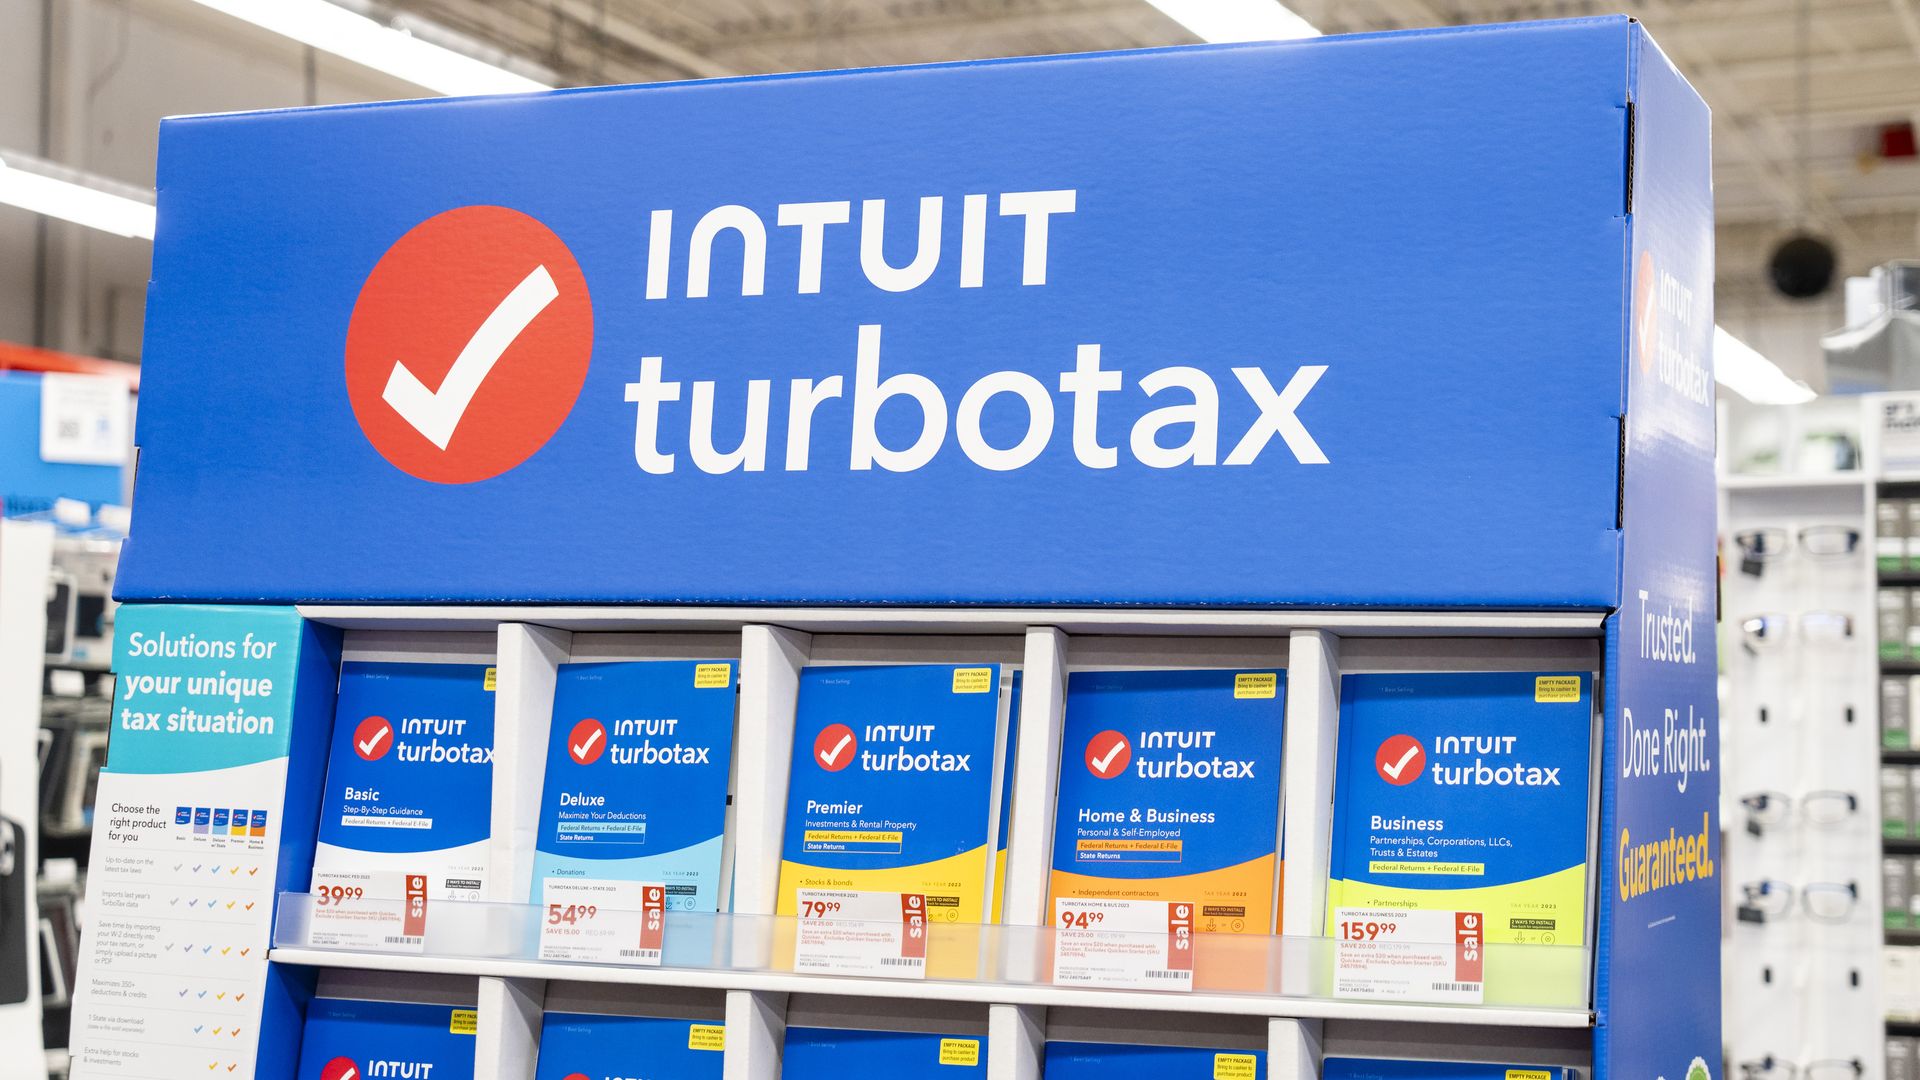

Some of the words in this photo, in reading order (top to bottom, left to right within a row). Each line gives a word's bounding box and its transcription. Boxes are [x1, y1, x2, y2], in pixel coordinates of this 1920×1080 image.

[646, 190, 1076, 299] INTUIT
[1660, 269, 1692, 326] INTUIT
[1659, 331, 1709, 407] turbotax
[624, 324, 1331, 474] turbotax
[1639, 589, 1695, 664] Trusted.
[128, 632, 235, 659] Solutions
[243, 633, 276, 659] for
[124, 675, 181, 700] your
[187, 671, 272, 703] unique
[121, 708, 160, 731] tax
[166, 706, 274, 734] situation
[401, 719, 466, 735] INTUIT
[614, 719, 678, 735] INTUIT
[865, 725, 935, 742] INTUIT
[1140, 731, 1215, 748] INTUIT
[397, 739, 495, 764] turbotax
[610, 740, 710, 764] turbotax
[1435, 736, 1516, 754] INTUIT
[1622, 707, 1660, 779] Done
[1663, 704, 1711, 794] Right.
[861, 746, 970, 772] turbotax
[1136, 752, 1255, 778] turbotax
[1432, 758, 1561, 786] turbotax
[344, 787, 380, 801] Basic
[560, 792, 605, 806] Deluxe
[112, 803, 144, 814] Choose
[146, 804, 160, 814] the
[343, 805, 388, 815] Step-By-Step
[389, 806, 423, 816] Guidance
[558, 812, 590, 820] Maximize
[591, 812, 606, 820] Your
[607, 812, 646, 820] Deductions
[806, 800, 863, 815] Premier
[1078, 808, 1125, 822] Home
[1129, 809, 1141, 822] &
[1146, 809, 1215, 823] Business
[110, 818, 130, 829] right
[132, 819, 167, 830] product
[805, 819, 850, 828] Investments
[859, 820, 883, 829] Rental
[884, 821, 917, 831] Property
[1077, 828, 1111, 837] Personal
[1121, 828, 1181, 838] Self-Employed
[1370, 816, 1444, 831] Business
[108, 831, 120, 840] for
[122, 833, 138, 843] you
[1370, 836, 1425, 847] Partnerships,
[1427, 837, 1486, 848] Corporations,
[1488, 838, 1513, 848] LLCs,
[1370, 848, 1395, 857] Trusts
[1397, 849, 1404, 857] &
[1406, 849, 1438, 858] Estates
[1620, 812, 1713, 902] Guaranteed.
[408, 877, 423, 918] sale
[1078, 889, 1120, 897] Independent
[645, 888, 660, 930] sale
[1374, 900, 1418, 908] Partnerships
[905, 896, 922, 938] sale
[1171, 905, 1189, 950] sale
[1459, 915, 1478, 961] sale
[368, 1060, 432, 1080] INTUIT
